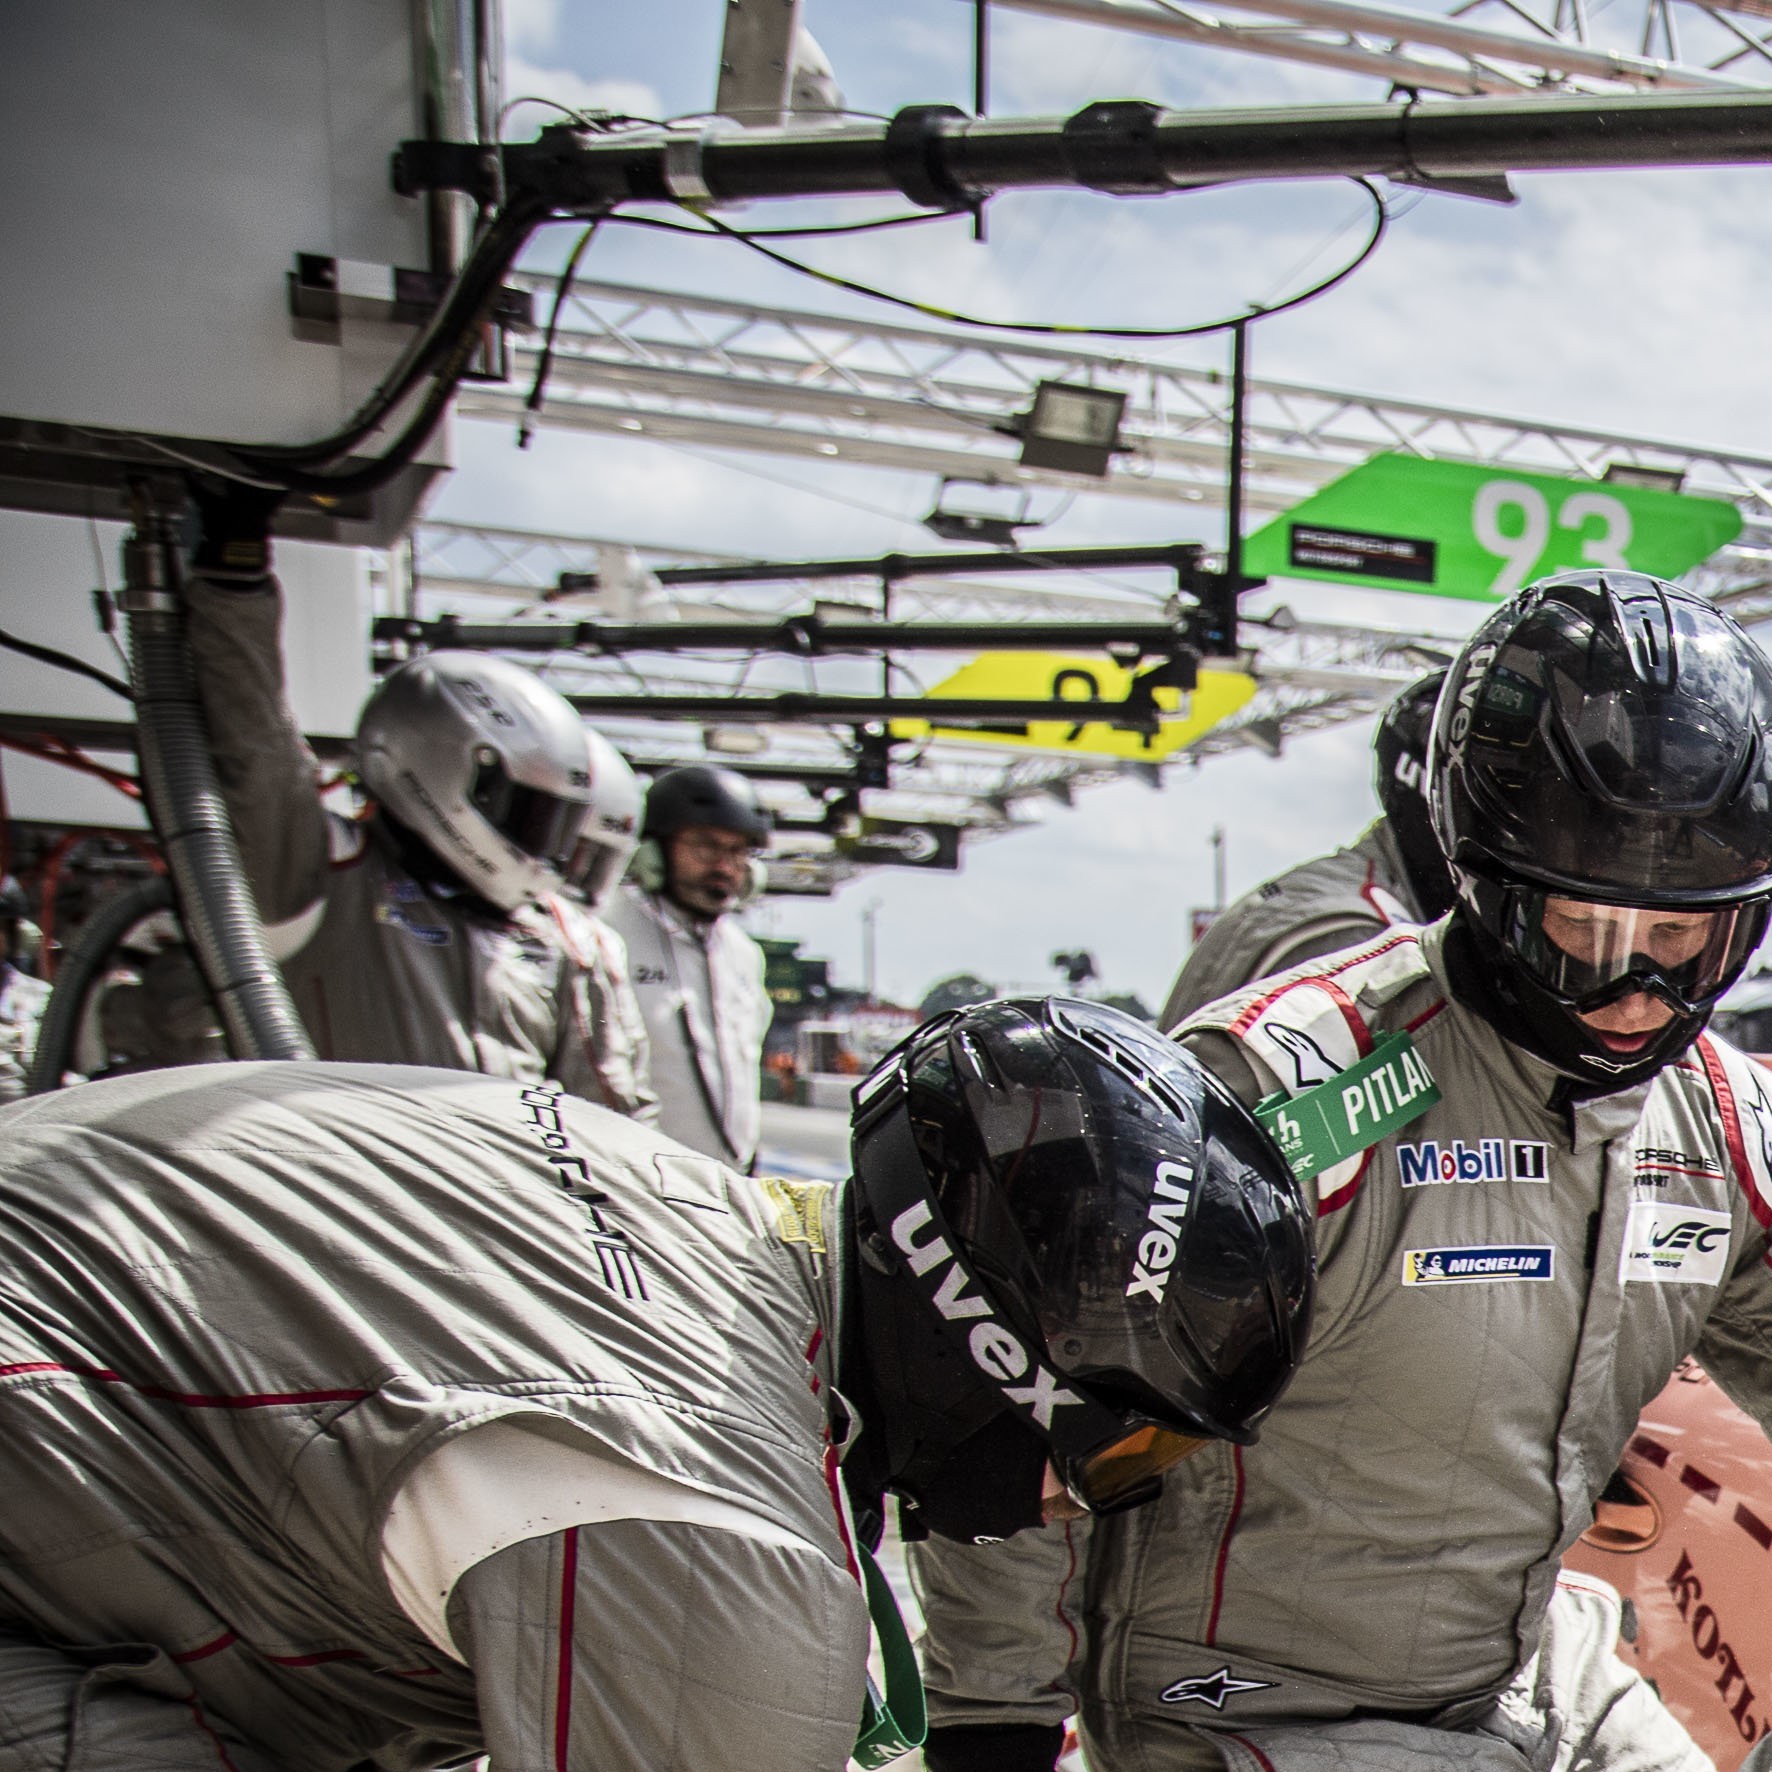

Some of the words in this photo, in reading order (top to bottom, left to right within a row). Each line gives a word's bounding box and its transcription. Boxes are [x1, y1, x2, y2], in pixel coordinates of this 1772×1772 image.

[1448, 642, 1498, 769] uvex
[1341, 1046, 1436, 1136] PITLAN
[1399, 1140, 1504, 1186] Mobil
[1126, 1159, 1195, 1305] uvex
[1448, 1257, 1542, 1273] MICHELIN
[890, 1198, 1086, 1432] uvex
[1666, 1547, 1772, 1745] KOTL
